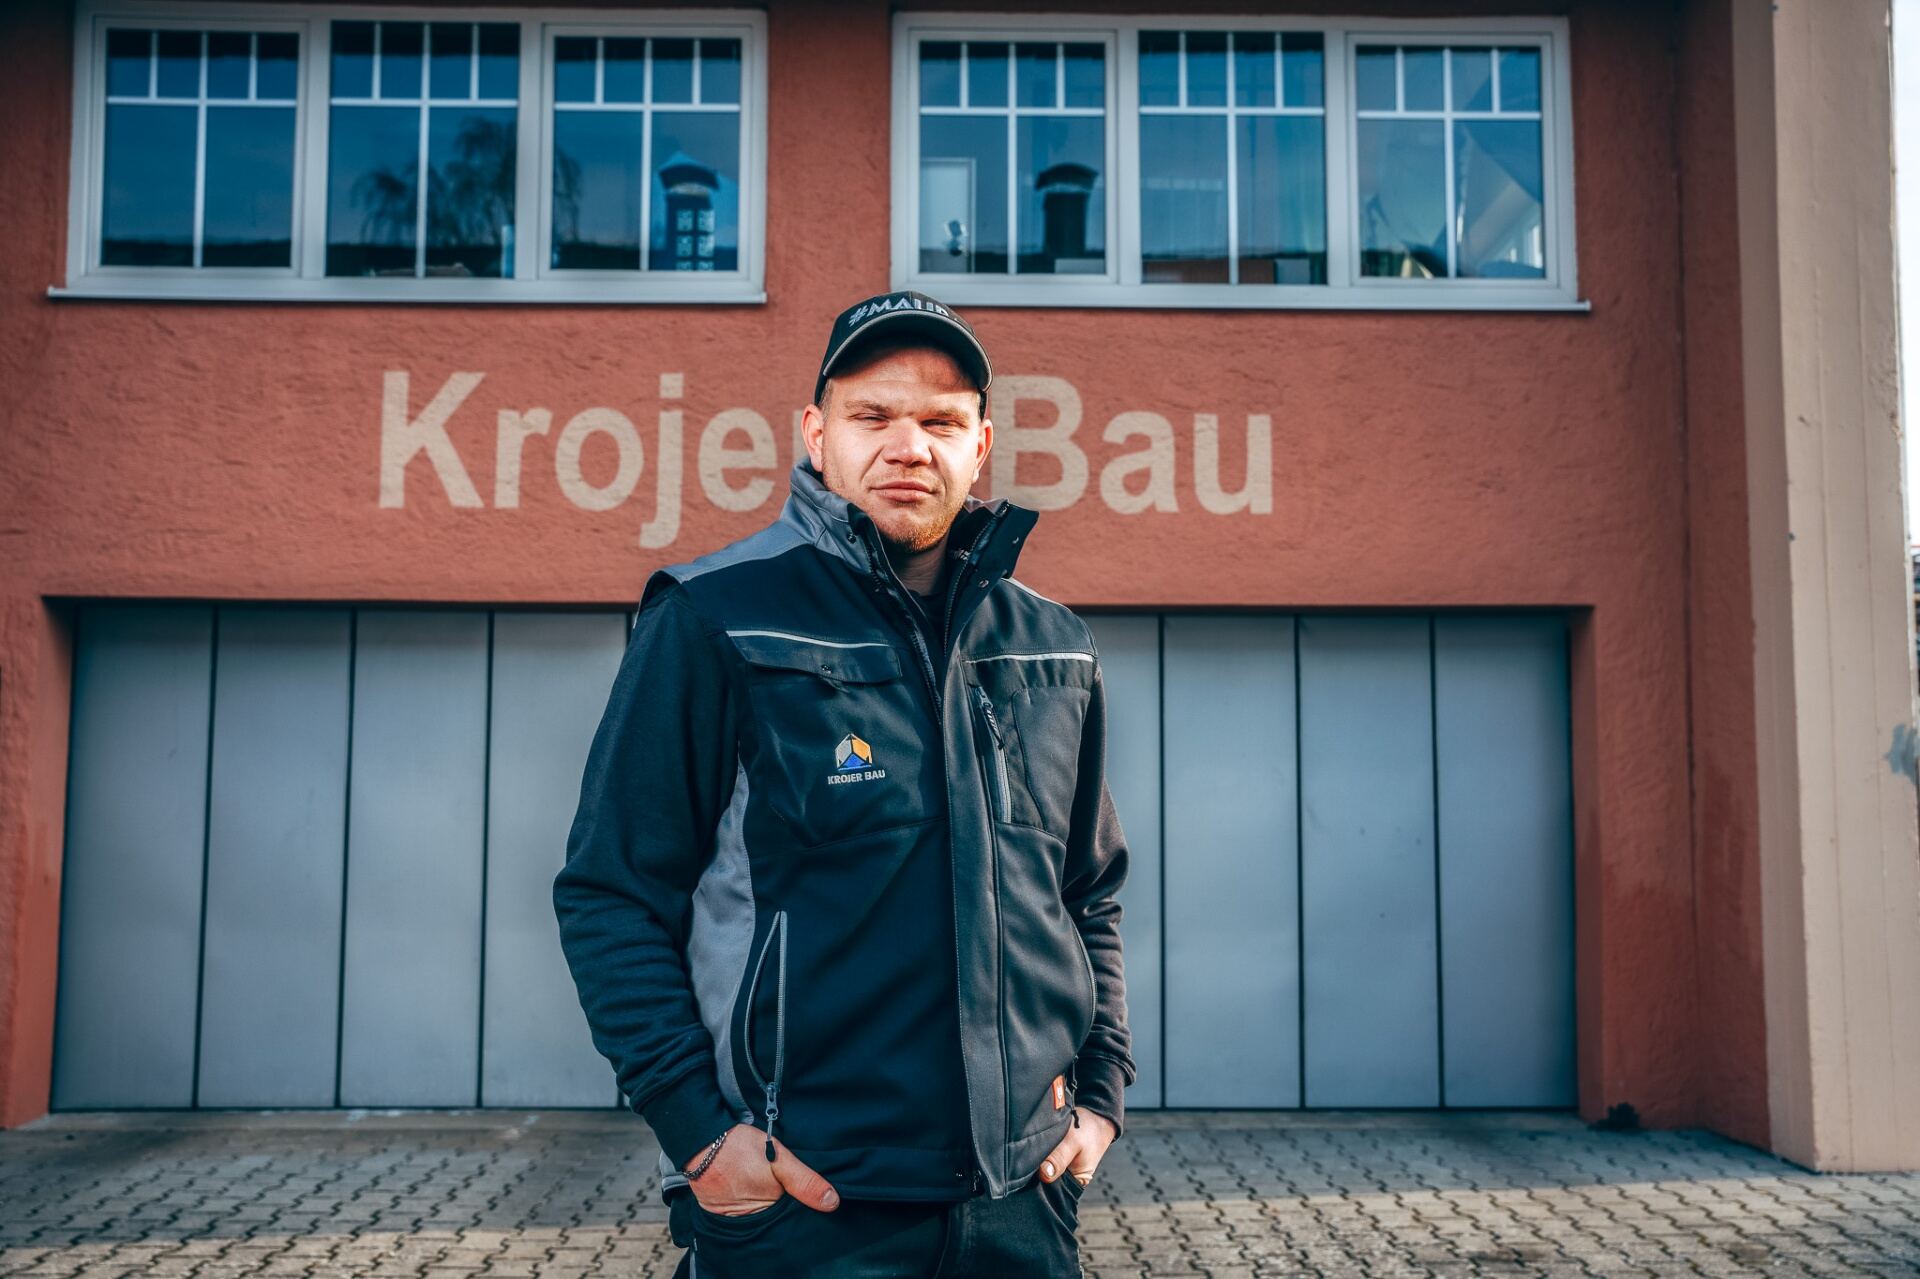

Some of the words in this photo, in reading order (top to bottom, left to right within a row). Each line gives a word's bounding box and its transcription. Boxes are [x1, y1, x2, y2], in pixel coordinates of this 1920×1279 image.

[379, 371, 806, 548] Kroje
[990, 374, 1273, 515] Bau
[827, 773, 862, 785] KROJER
[864, 769, 886, 780] BAU
